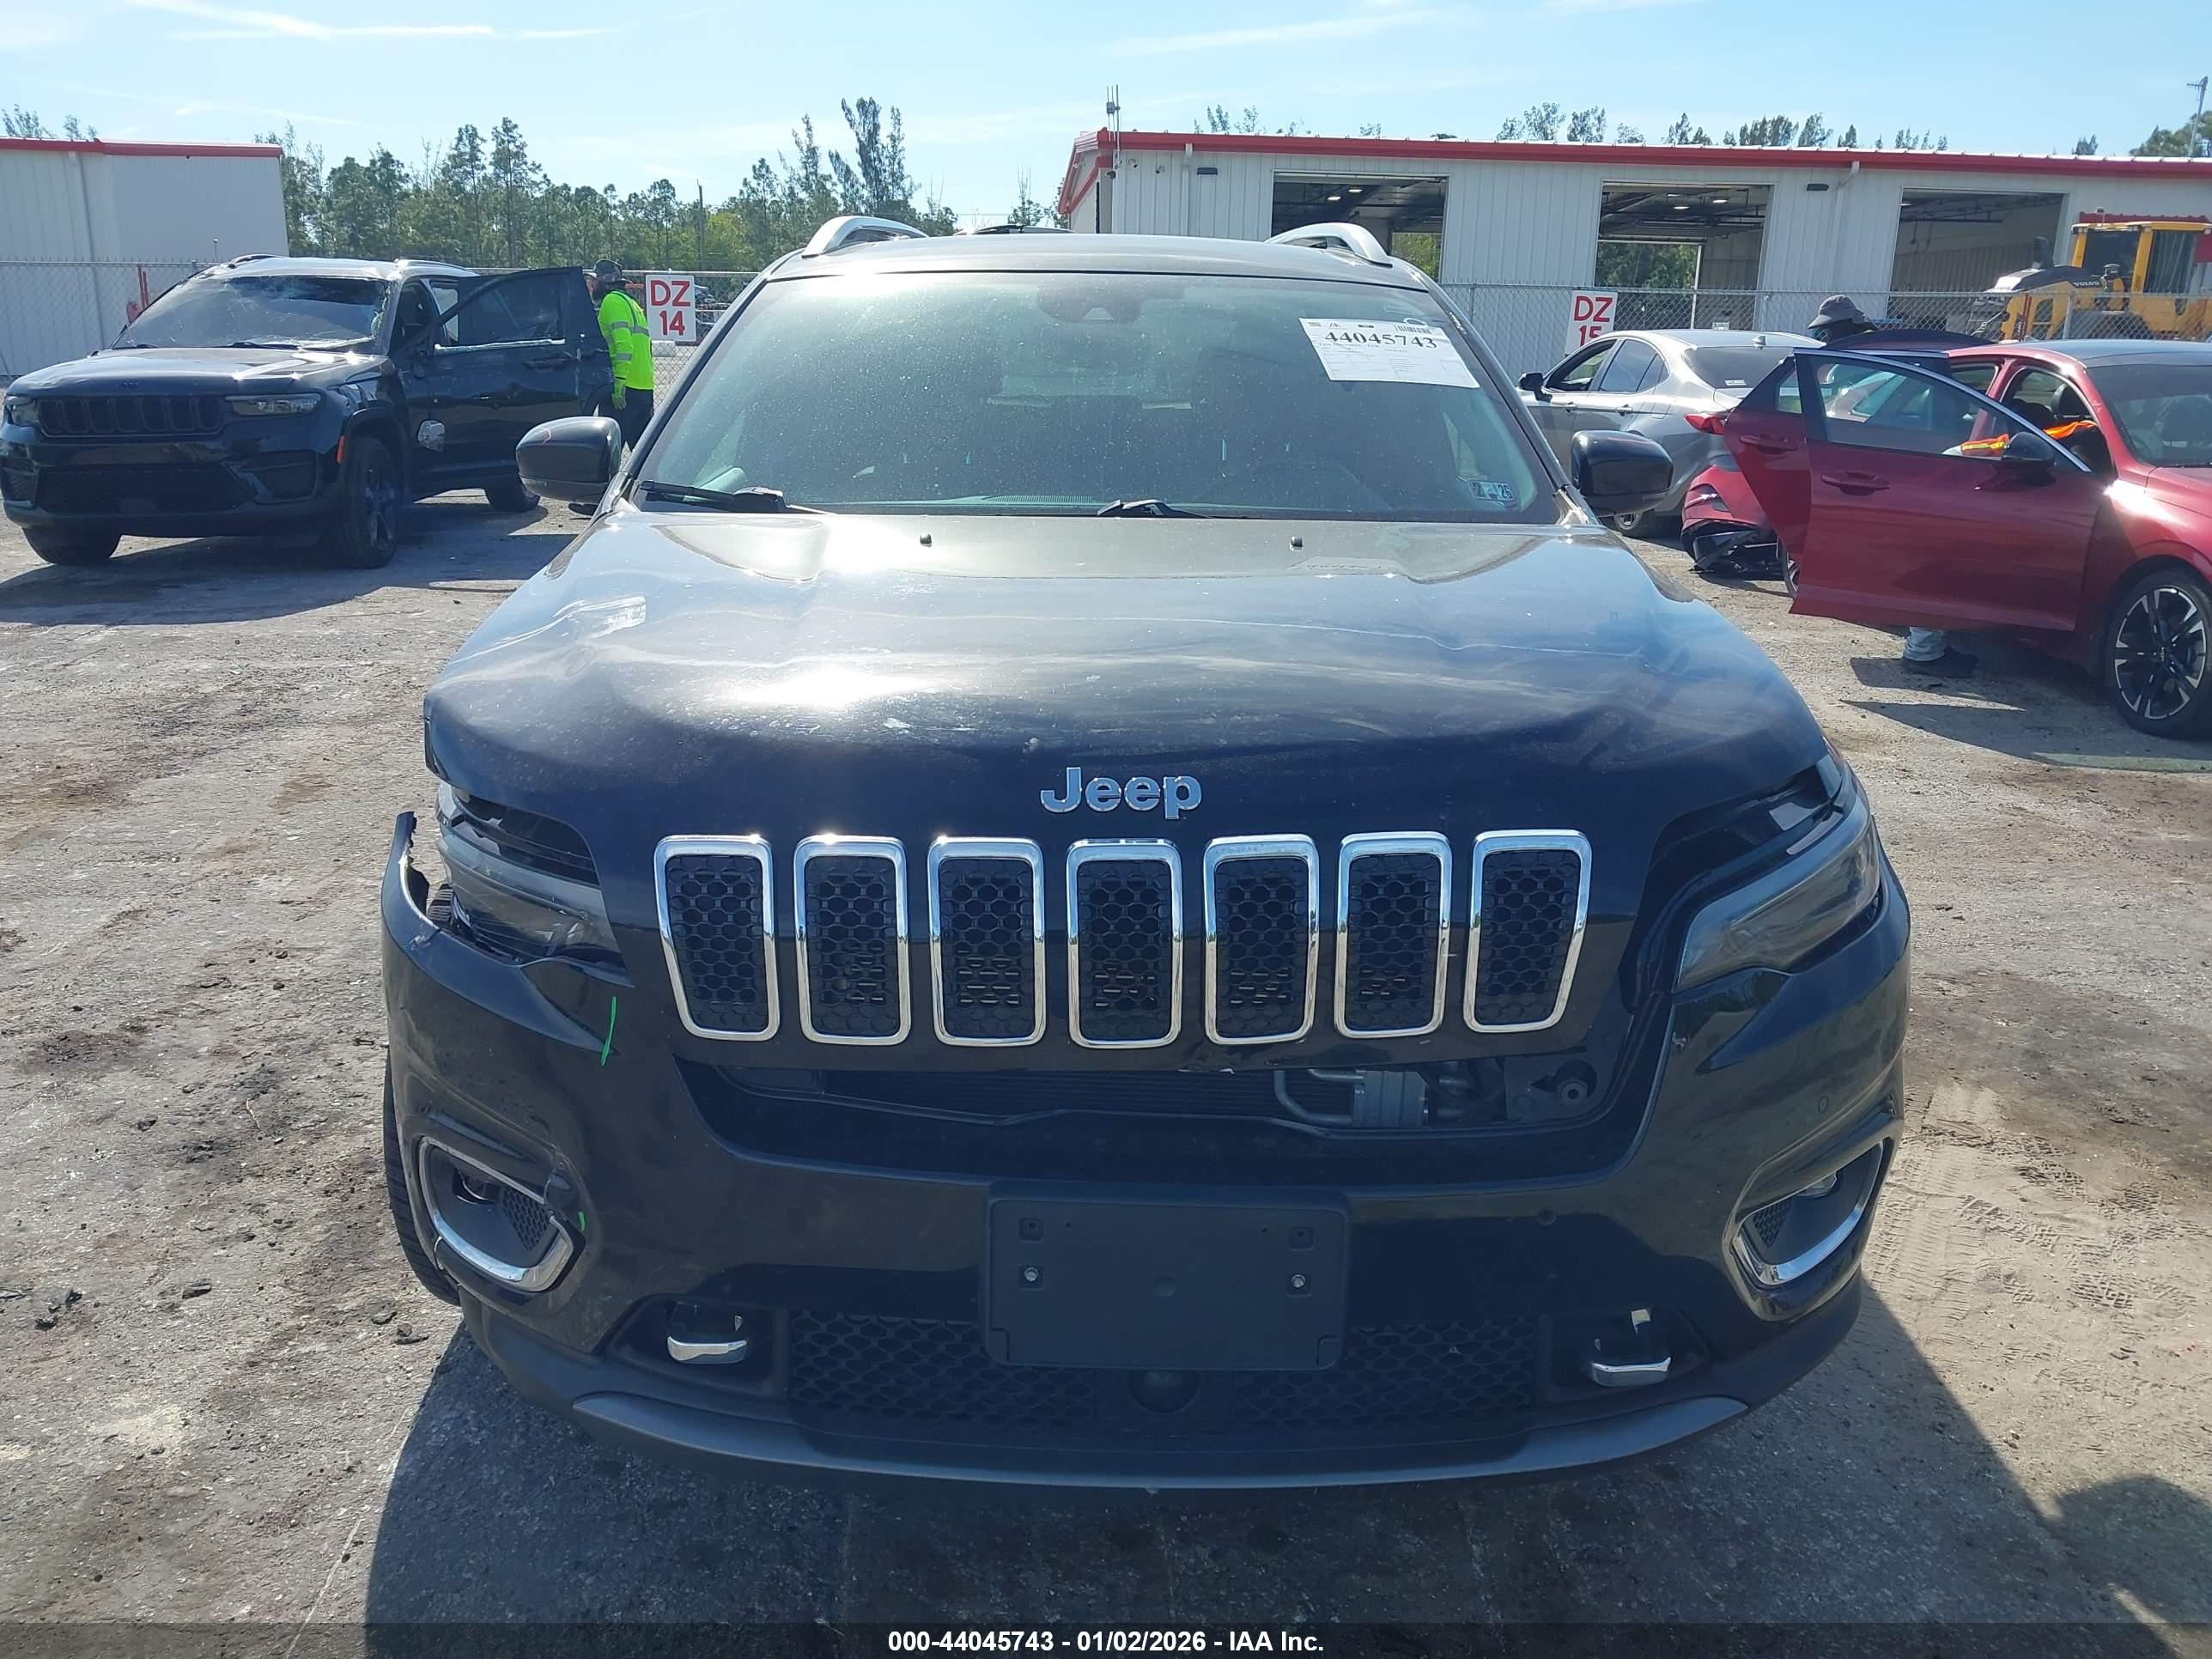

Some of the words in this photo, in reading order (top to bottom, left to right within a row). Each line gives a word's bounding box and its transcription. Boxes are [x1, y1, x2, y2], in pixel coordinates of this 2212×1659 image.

[650, 280, 691, 307] DZ
[1573, 295, 1613, 322] DZ
[659, 310, 685, 336] 14
[1325, 331, 1437, 349] 44045743
[1498, 484, 1513, 499] 26
[1040, 766, 1202, 820] Jeep
